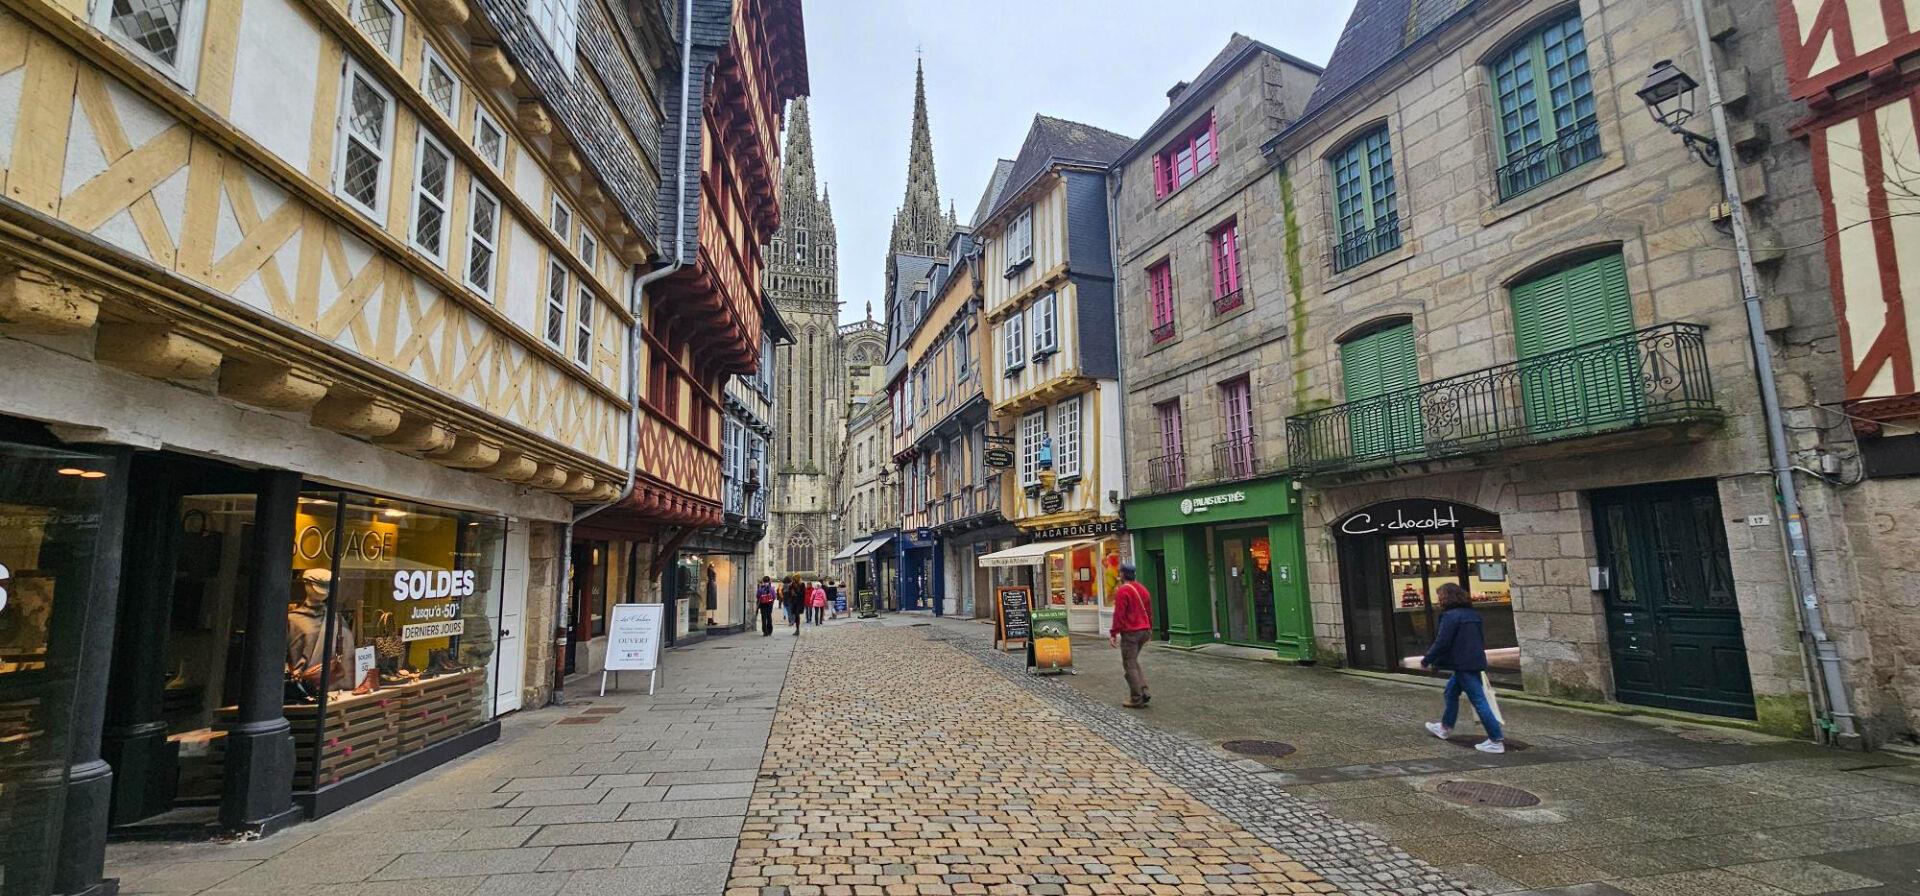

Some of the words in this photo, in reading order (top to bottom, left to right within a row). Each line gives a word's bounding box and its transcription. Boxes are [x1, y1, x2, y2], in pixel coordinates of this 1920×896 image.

[1034, 522, 1117, 539] MACARONERIE
[292, 525, 394, 562] OCAGE
[393, 569, 475, 601] SOLDES
[405, 625, 439, 639] DERNIERS
[440, 621, 462, 636] JOURS
